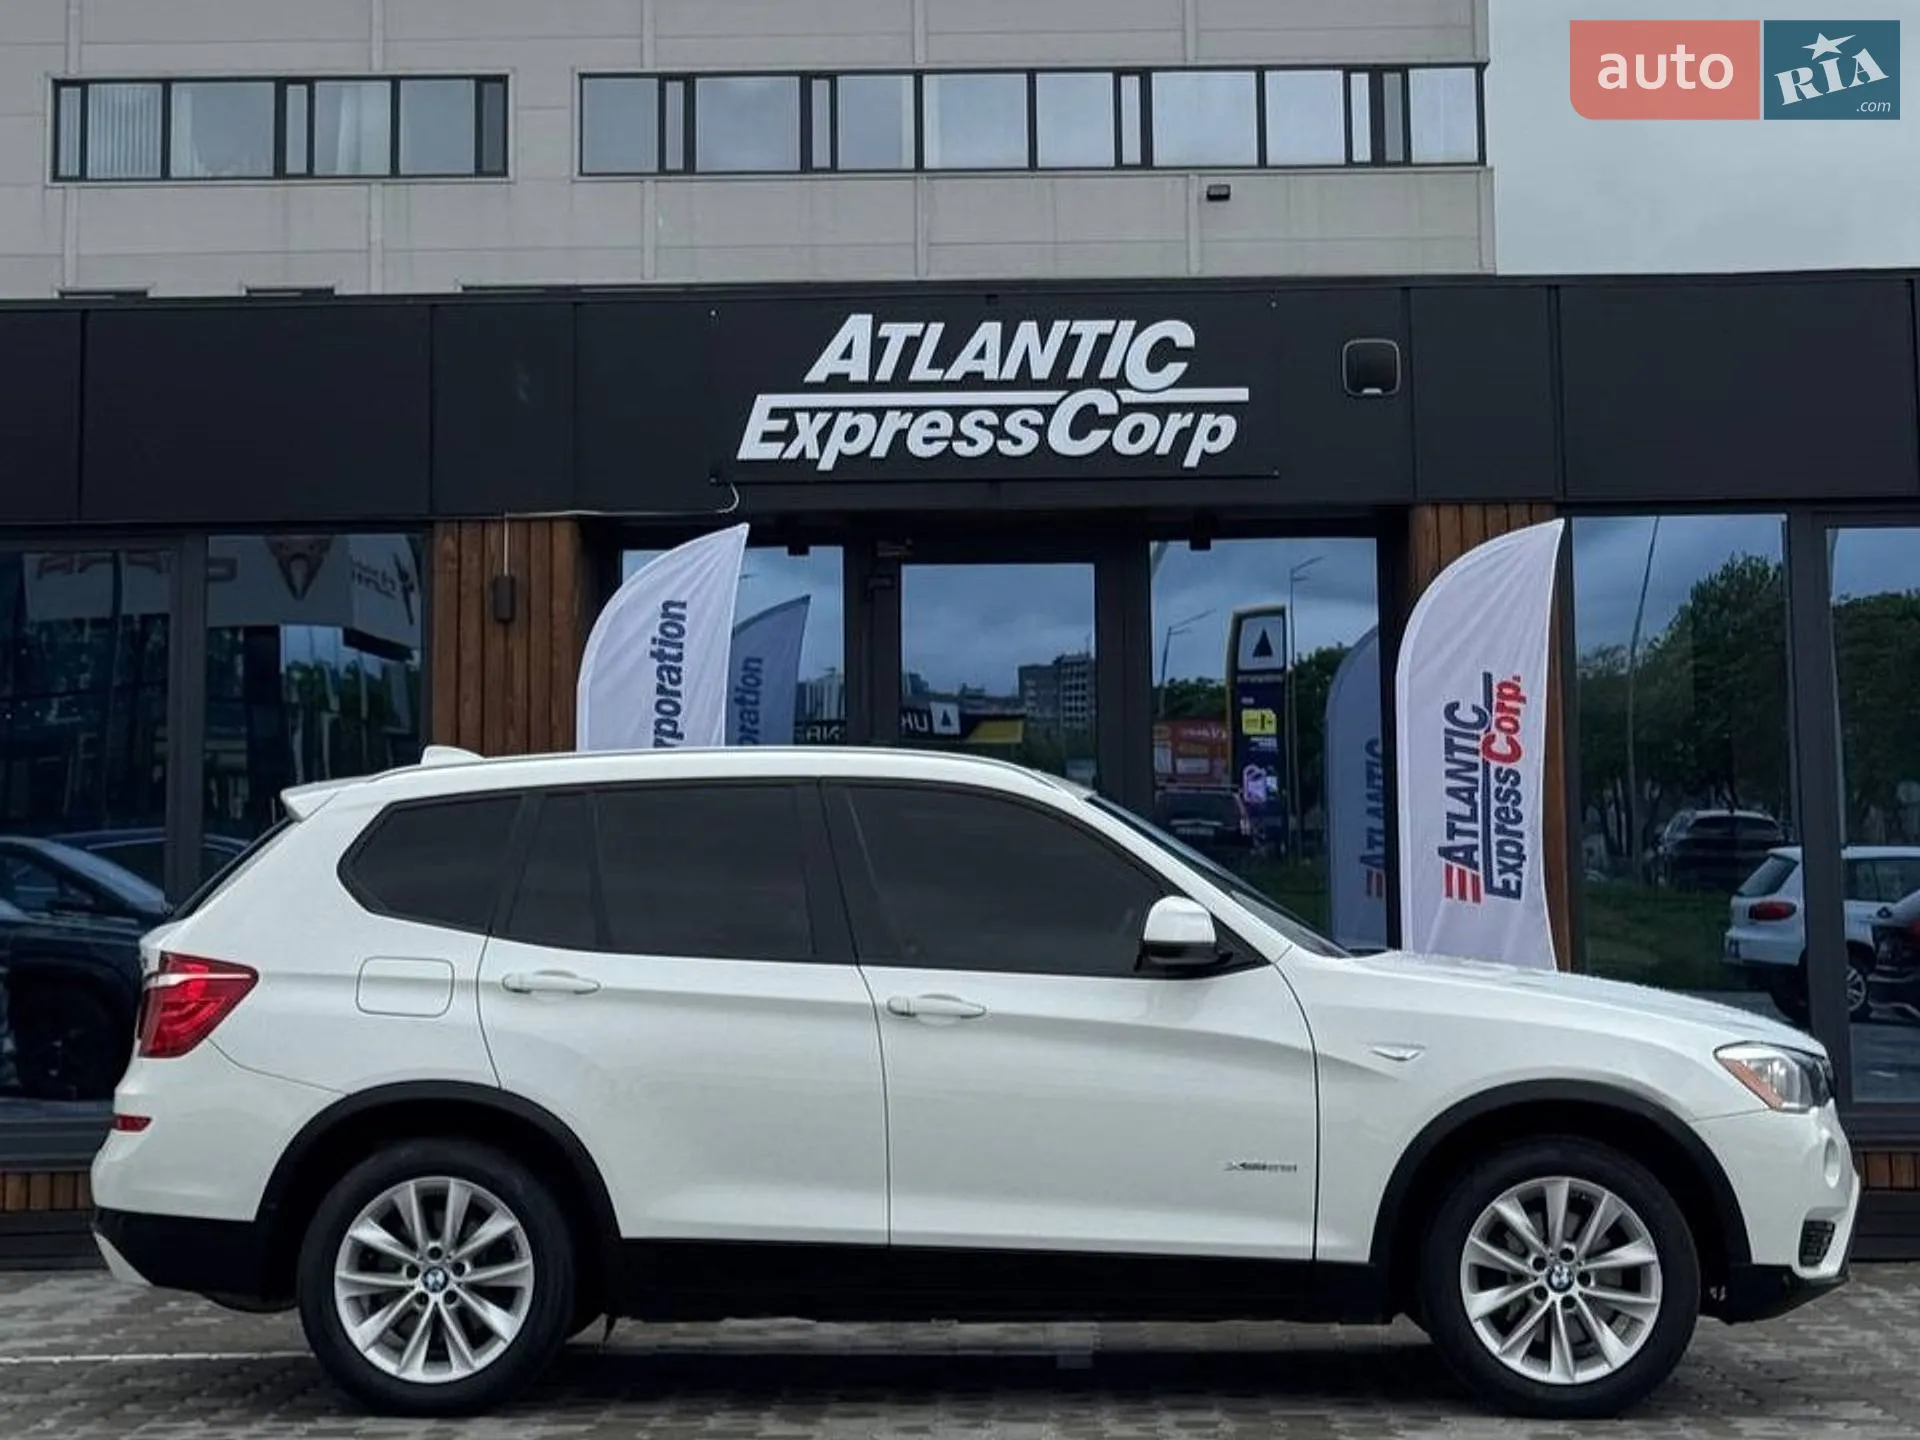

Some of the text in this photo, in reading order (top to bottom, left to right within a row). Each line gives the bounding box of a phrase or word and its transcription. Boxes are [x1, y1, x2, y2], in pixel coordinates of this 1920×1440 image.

[803, 313, 1196, 391] ATLANTIC
[736, 391, 1238, 471] ExpressCorp
[1438, 701, 1490, 874] ATLANTIC
